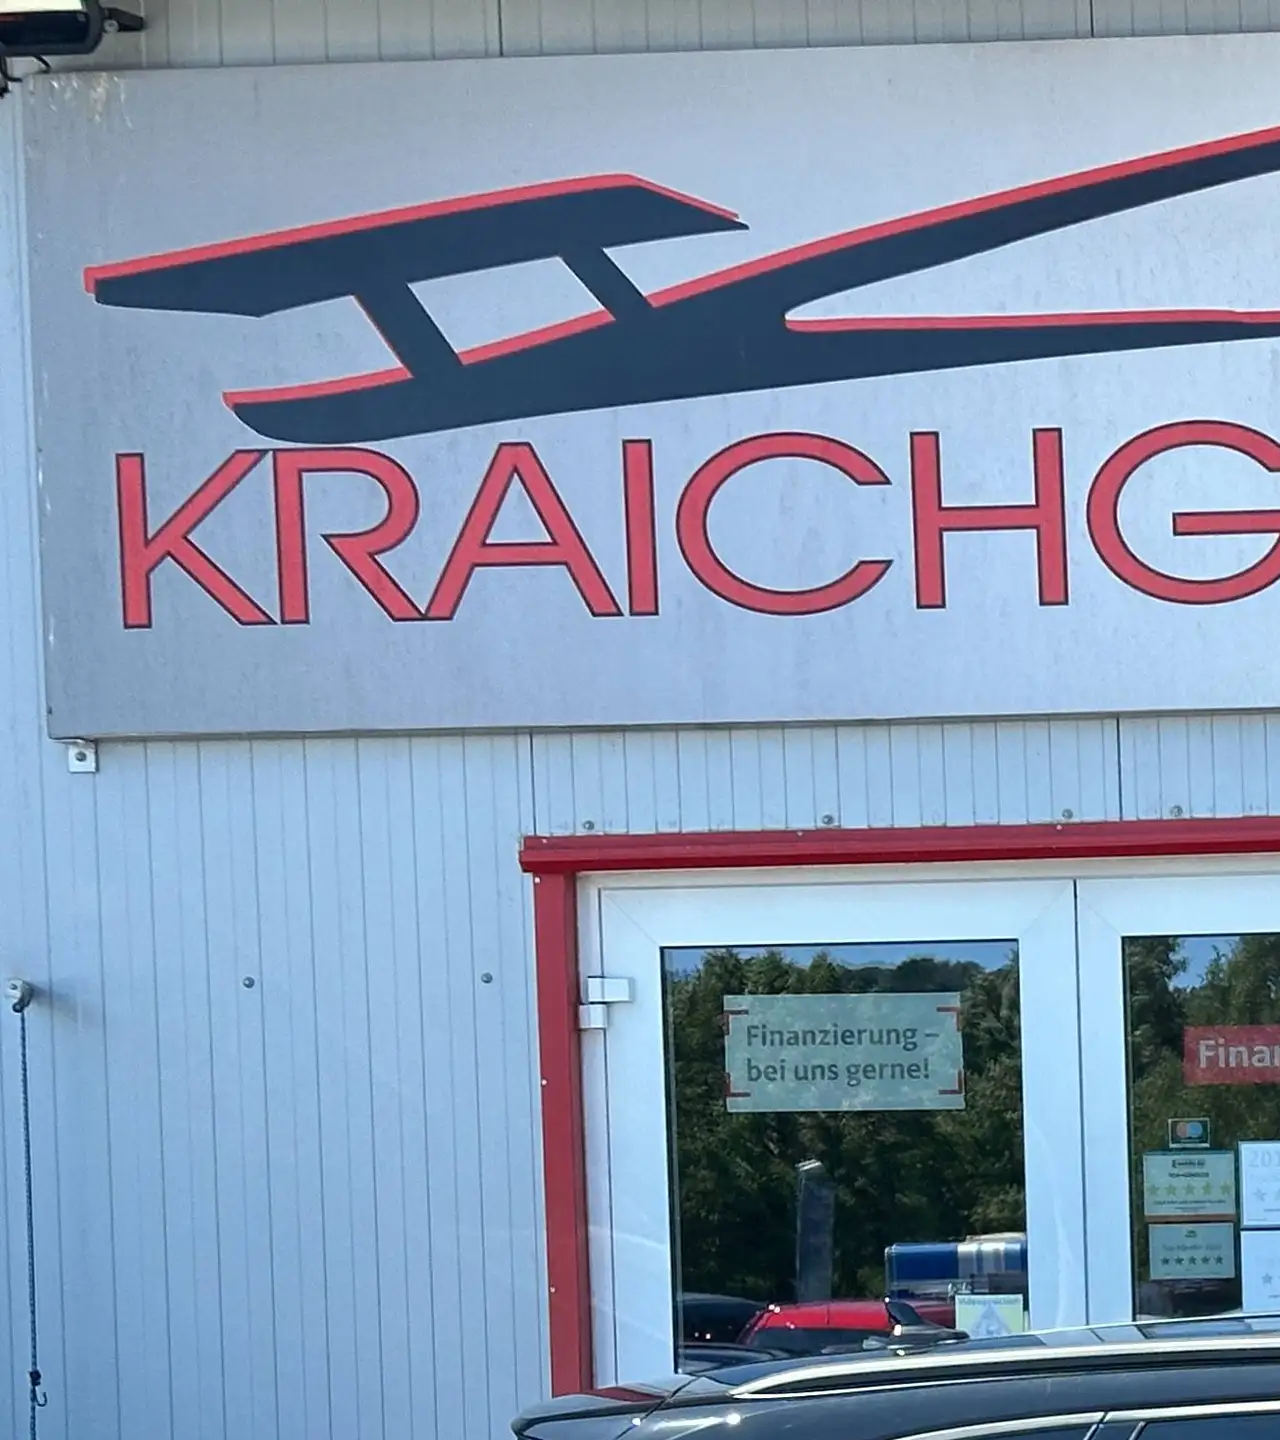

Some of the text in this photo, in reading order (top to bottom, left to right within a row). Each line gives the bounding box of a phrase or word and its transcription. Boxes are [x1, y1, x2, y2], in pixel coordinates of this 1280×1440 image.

[746, 1023, 918, 1051] Finanzierung
[746, 1057, 930, 1087] bei uns gerne!
